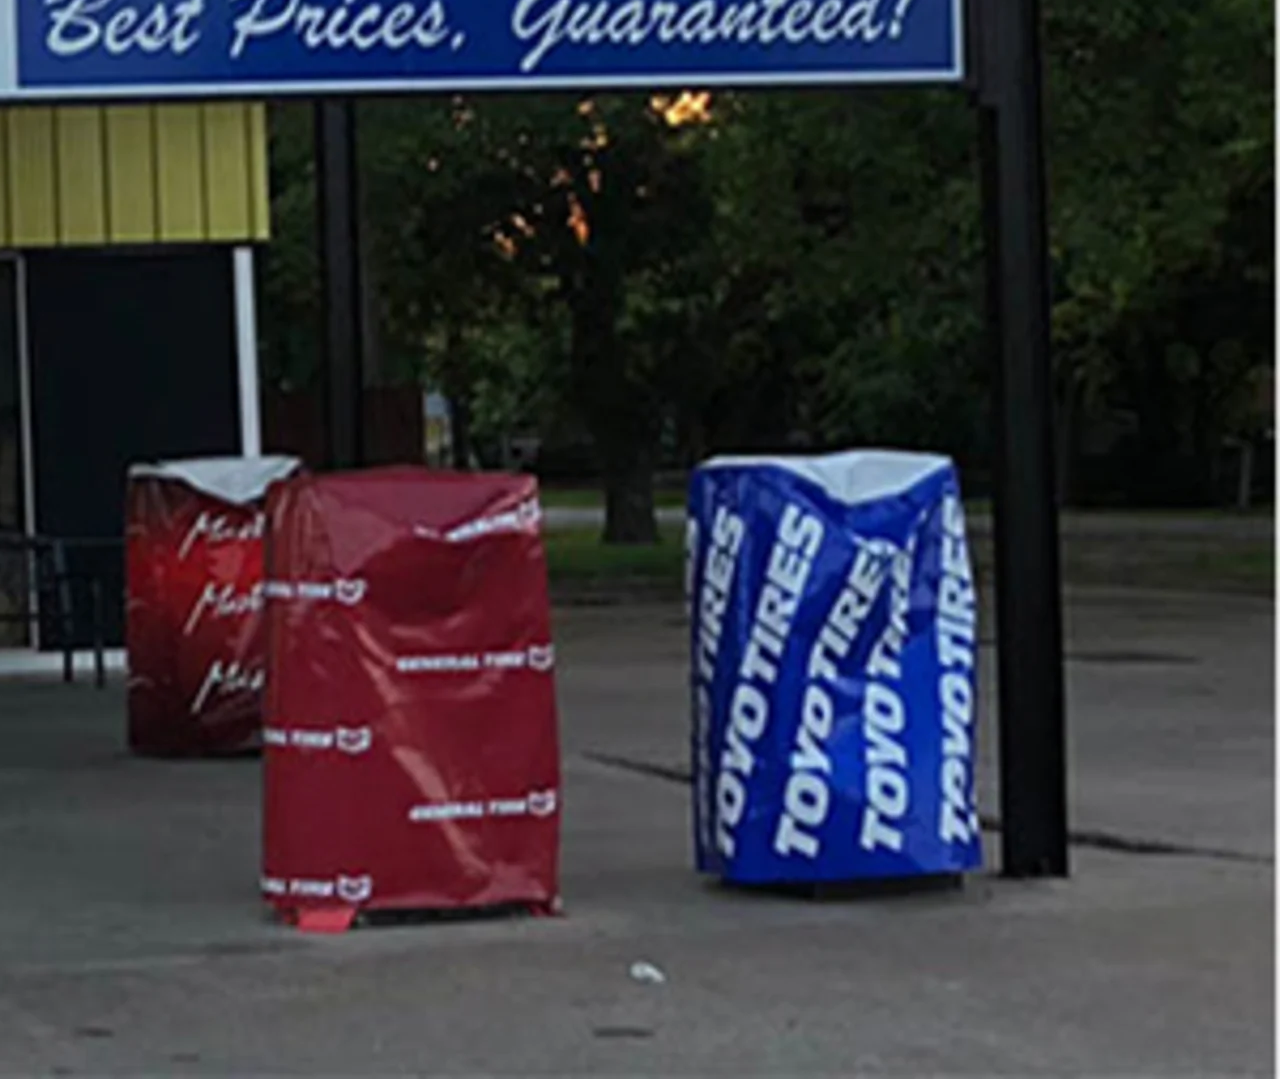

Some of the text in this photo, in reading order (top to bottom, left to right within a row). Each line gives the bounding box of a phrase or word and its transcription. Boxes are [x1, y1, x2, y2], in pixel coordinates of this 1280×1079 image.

[714, 503, 826, 859] TOYO TIRES
[859, 679, 909, 854] TOYO
[773, 682, 835, 860] TOYO
